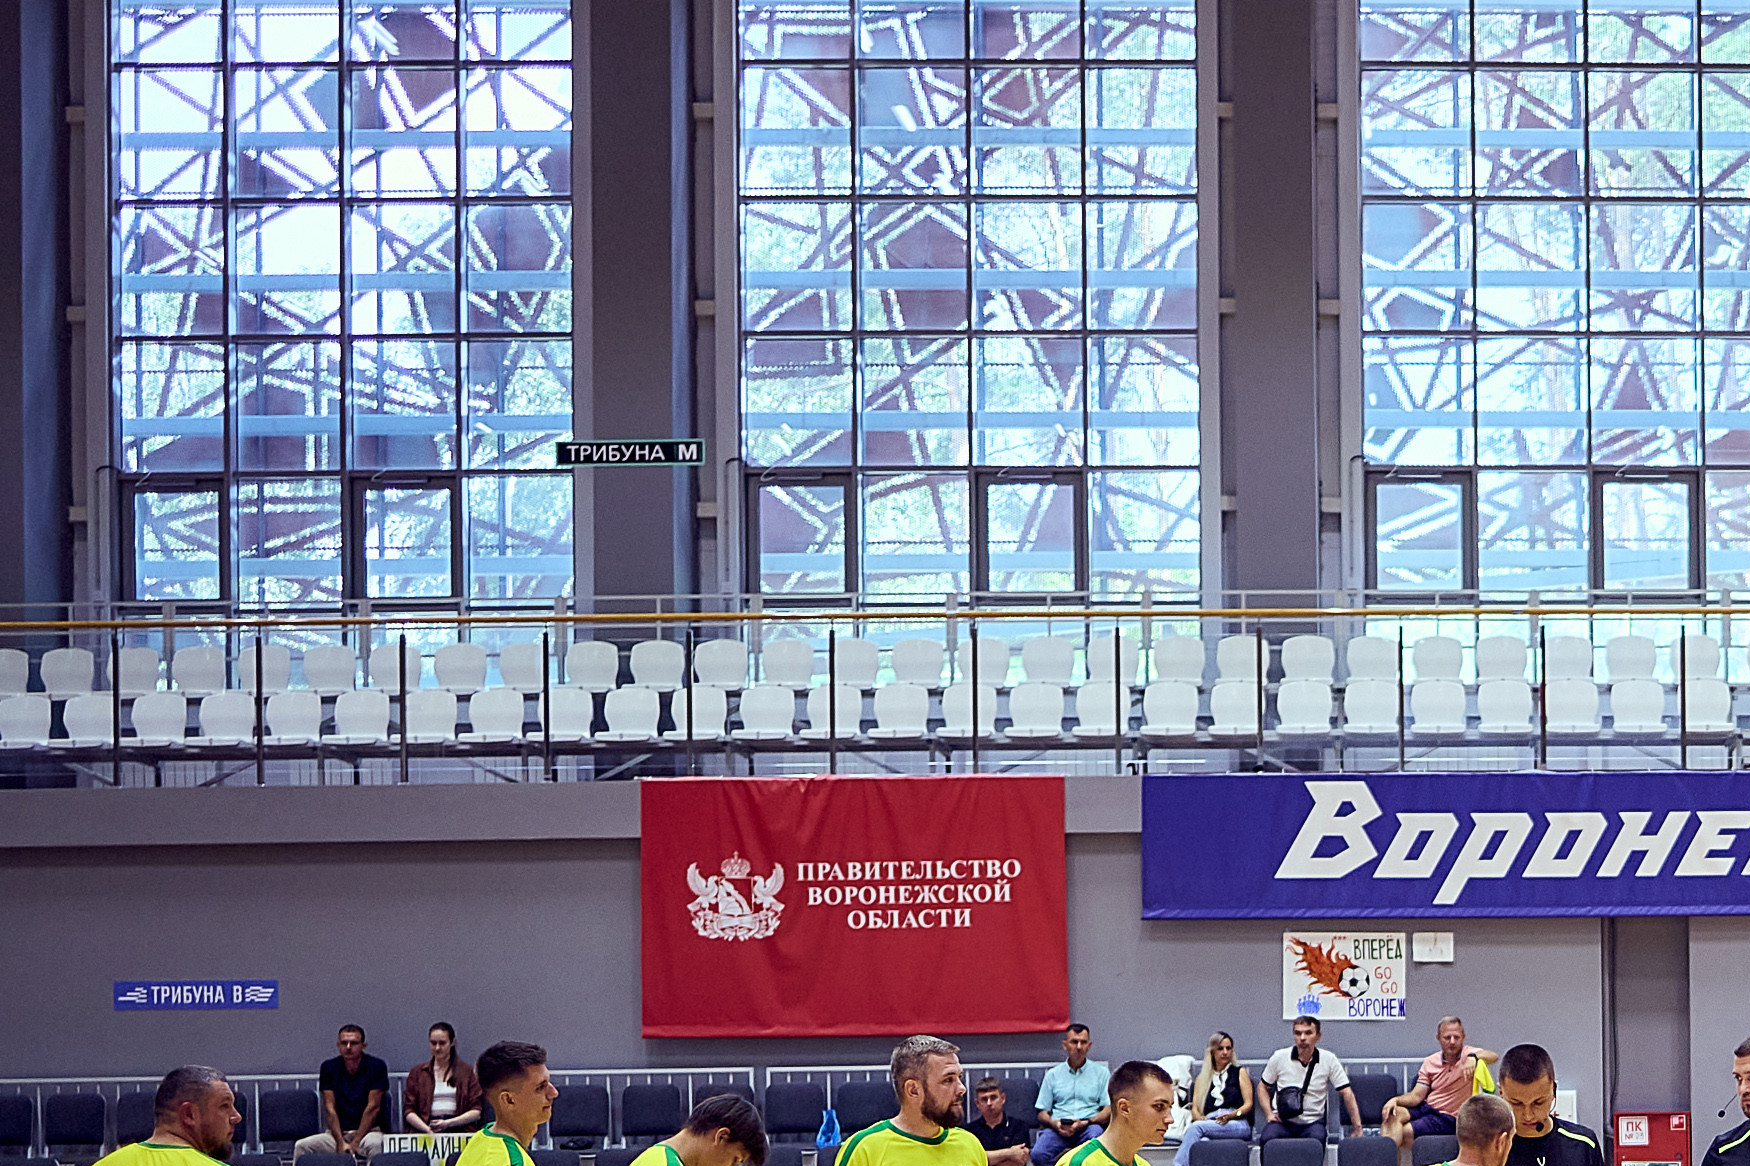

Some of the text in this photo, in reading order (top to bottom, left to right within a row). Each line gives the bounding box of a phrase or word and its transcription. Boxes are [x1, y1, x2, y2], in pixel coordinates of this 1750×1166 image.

[566, 443, 698, 462] ТРИБУНА М
[796, 858, 1022, 882] ПРАВИТЕЛЬСТВО
[807, 879, 1012, 906] ВОРОНЕЖСКОЙ
[847, 908, 972, 930] ОБЛАСТИ
[1353, 935, 1403, 961] ВПЕРЁД
[1374, 966, 1392, 980] GO
[151, 985, 243, 1004] ТРИБУНА В
[1380, 981, 1398, 994] GO
[1348, 998, 1406, 1017] ВОРОНЕЖ
[1626, 1121, 1642, 1131] ПК
